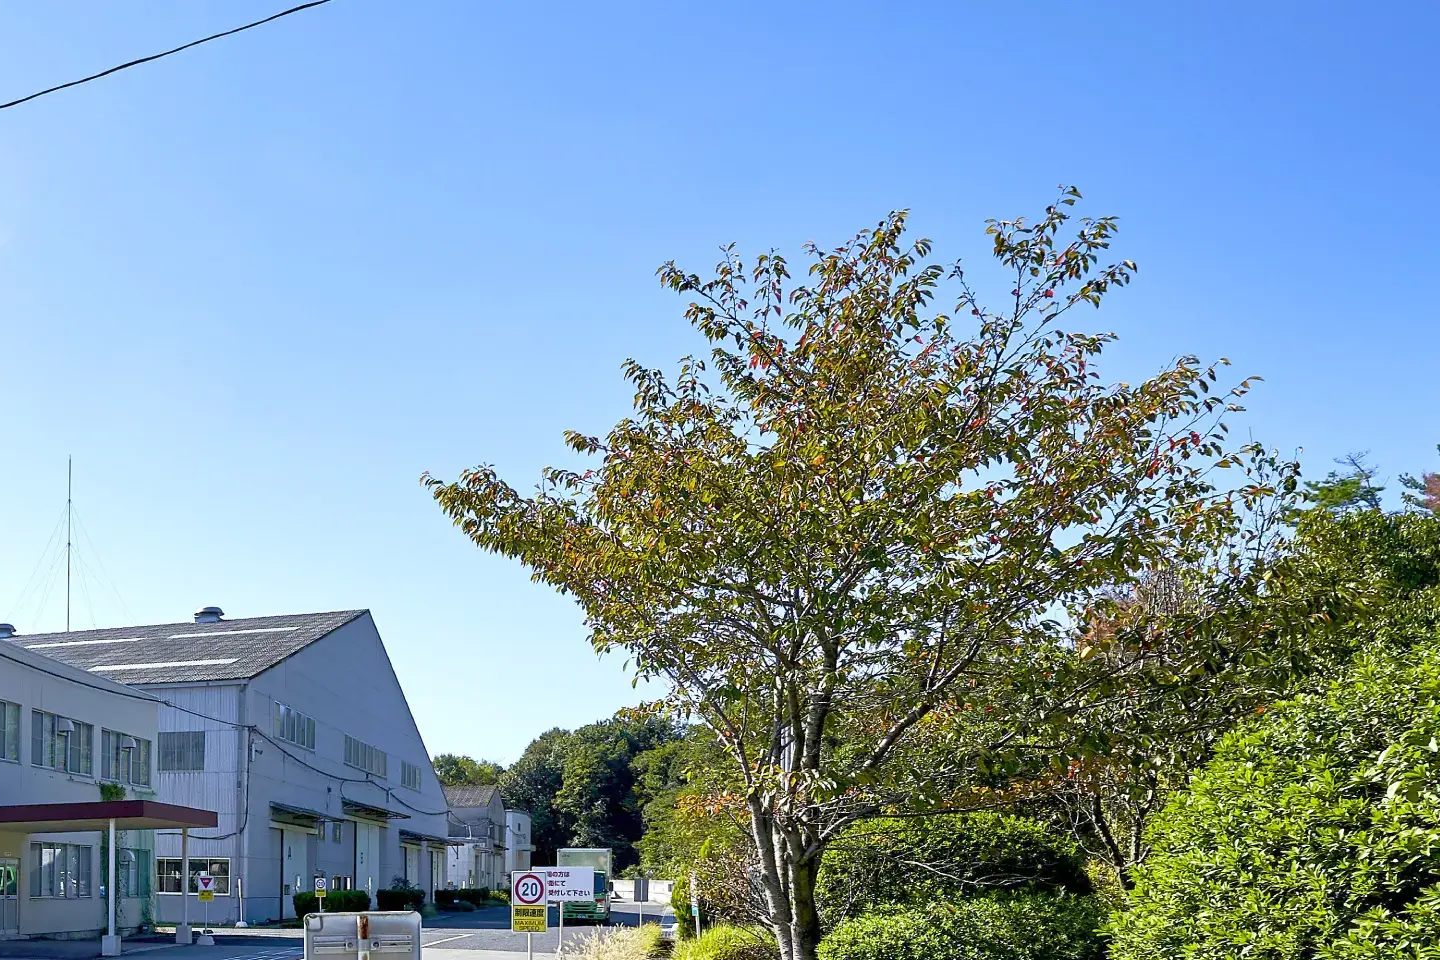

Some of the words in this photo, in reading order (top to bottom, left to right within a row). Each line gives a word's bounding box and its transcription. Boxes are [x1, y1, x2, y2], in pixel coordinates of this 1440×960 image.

[521, 882, 538, 896] 20
[515, 908, 544, 917] 制限速度
